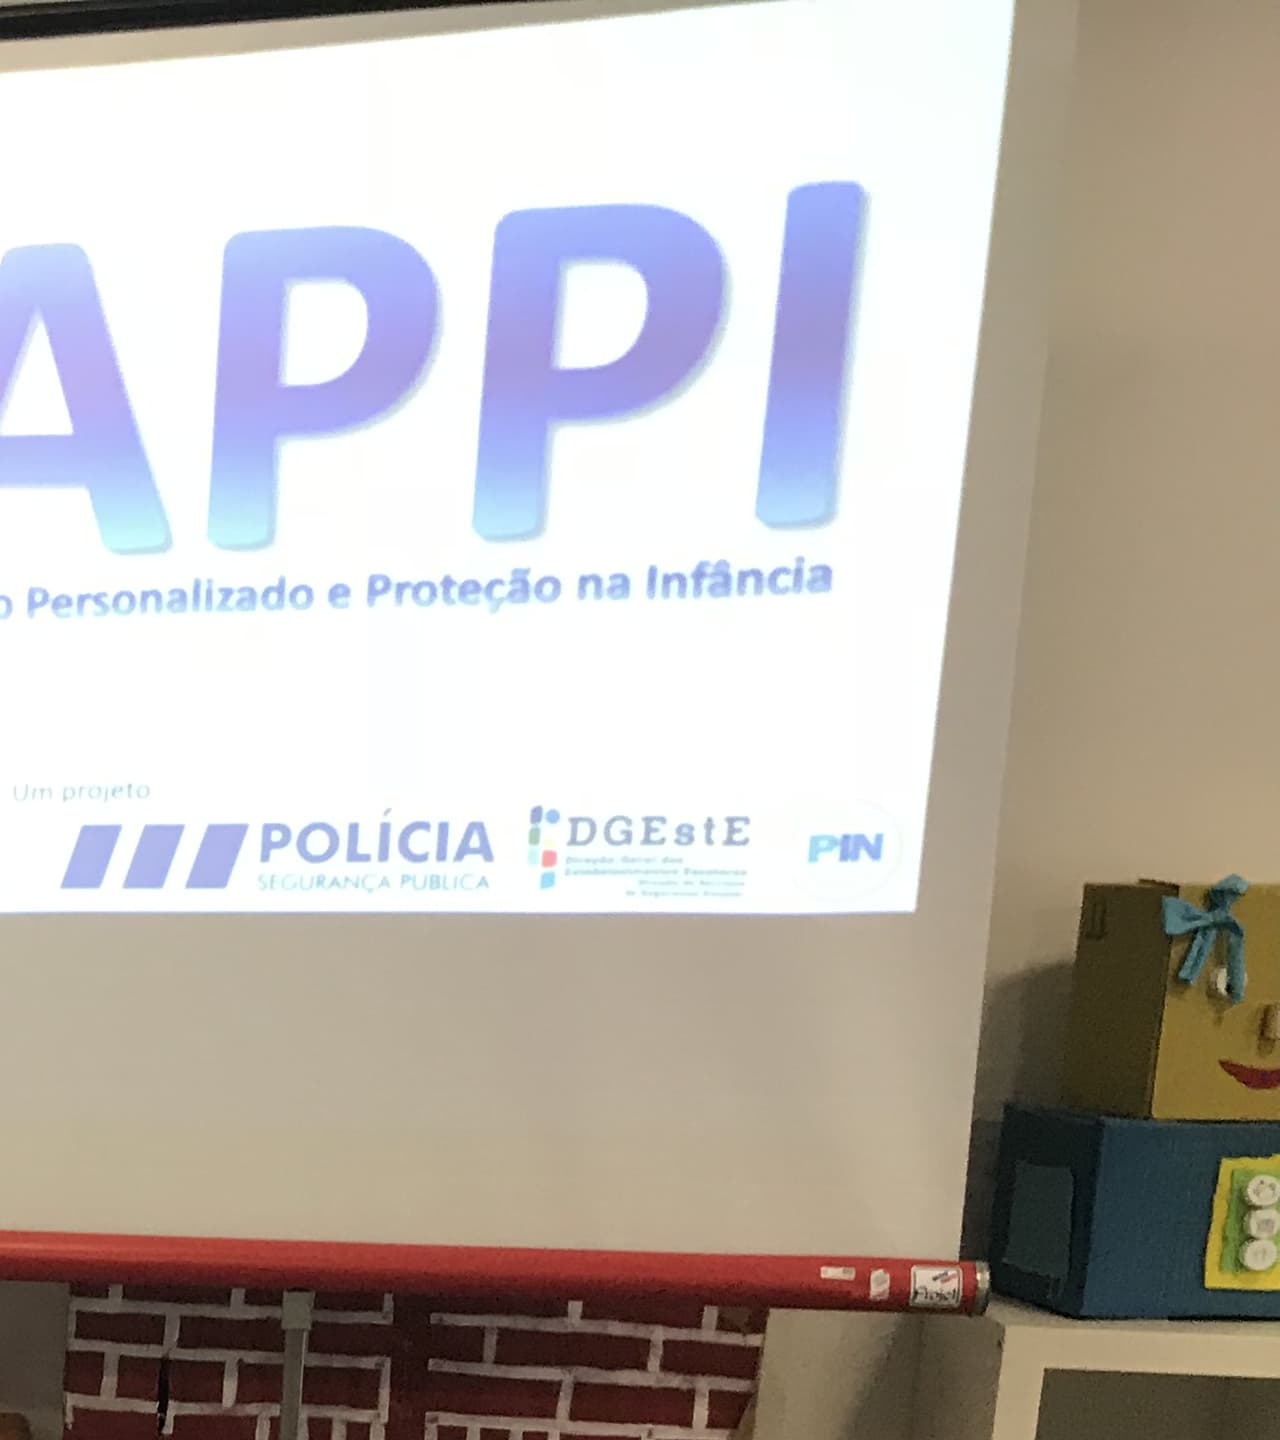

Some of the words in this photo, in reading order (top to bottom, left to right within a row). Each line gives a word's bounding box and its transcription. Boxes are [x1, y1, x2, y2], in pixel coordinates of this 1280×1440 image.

[26, 576, 315, 618] Personalizado
[327, 583, 352, 610] e
[366, 567, 562, 613] Proteção
[576, 573, 631, 601] na
[645, 555, 833, 602] Infância
[13, 783, 53, 801] Um
[62, 782, 151, 803] projeto
[259, 808, 496, 864] POLÍCIA
[566, 815, 751, 847] DGEstE
[806, 832, 885, 864] PIN
[256, 872, 392, 896] SEGURANÇA
